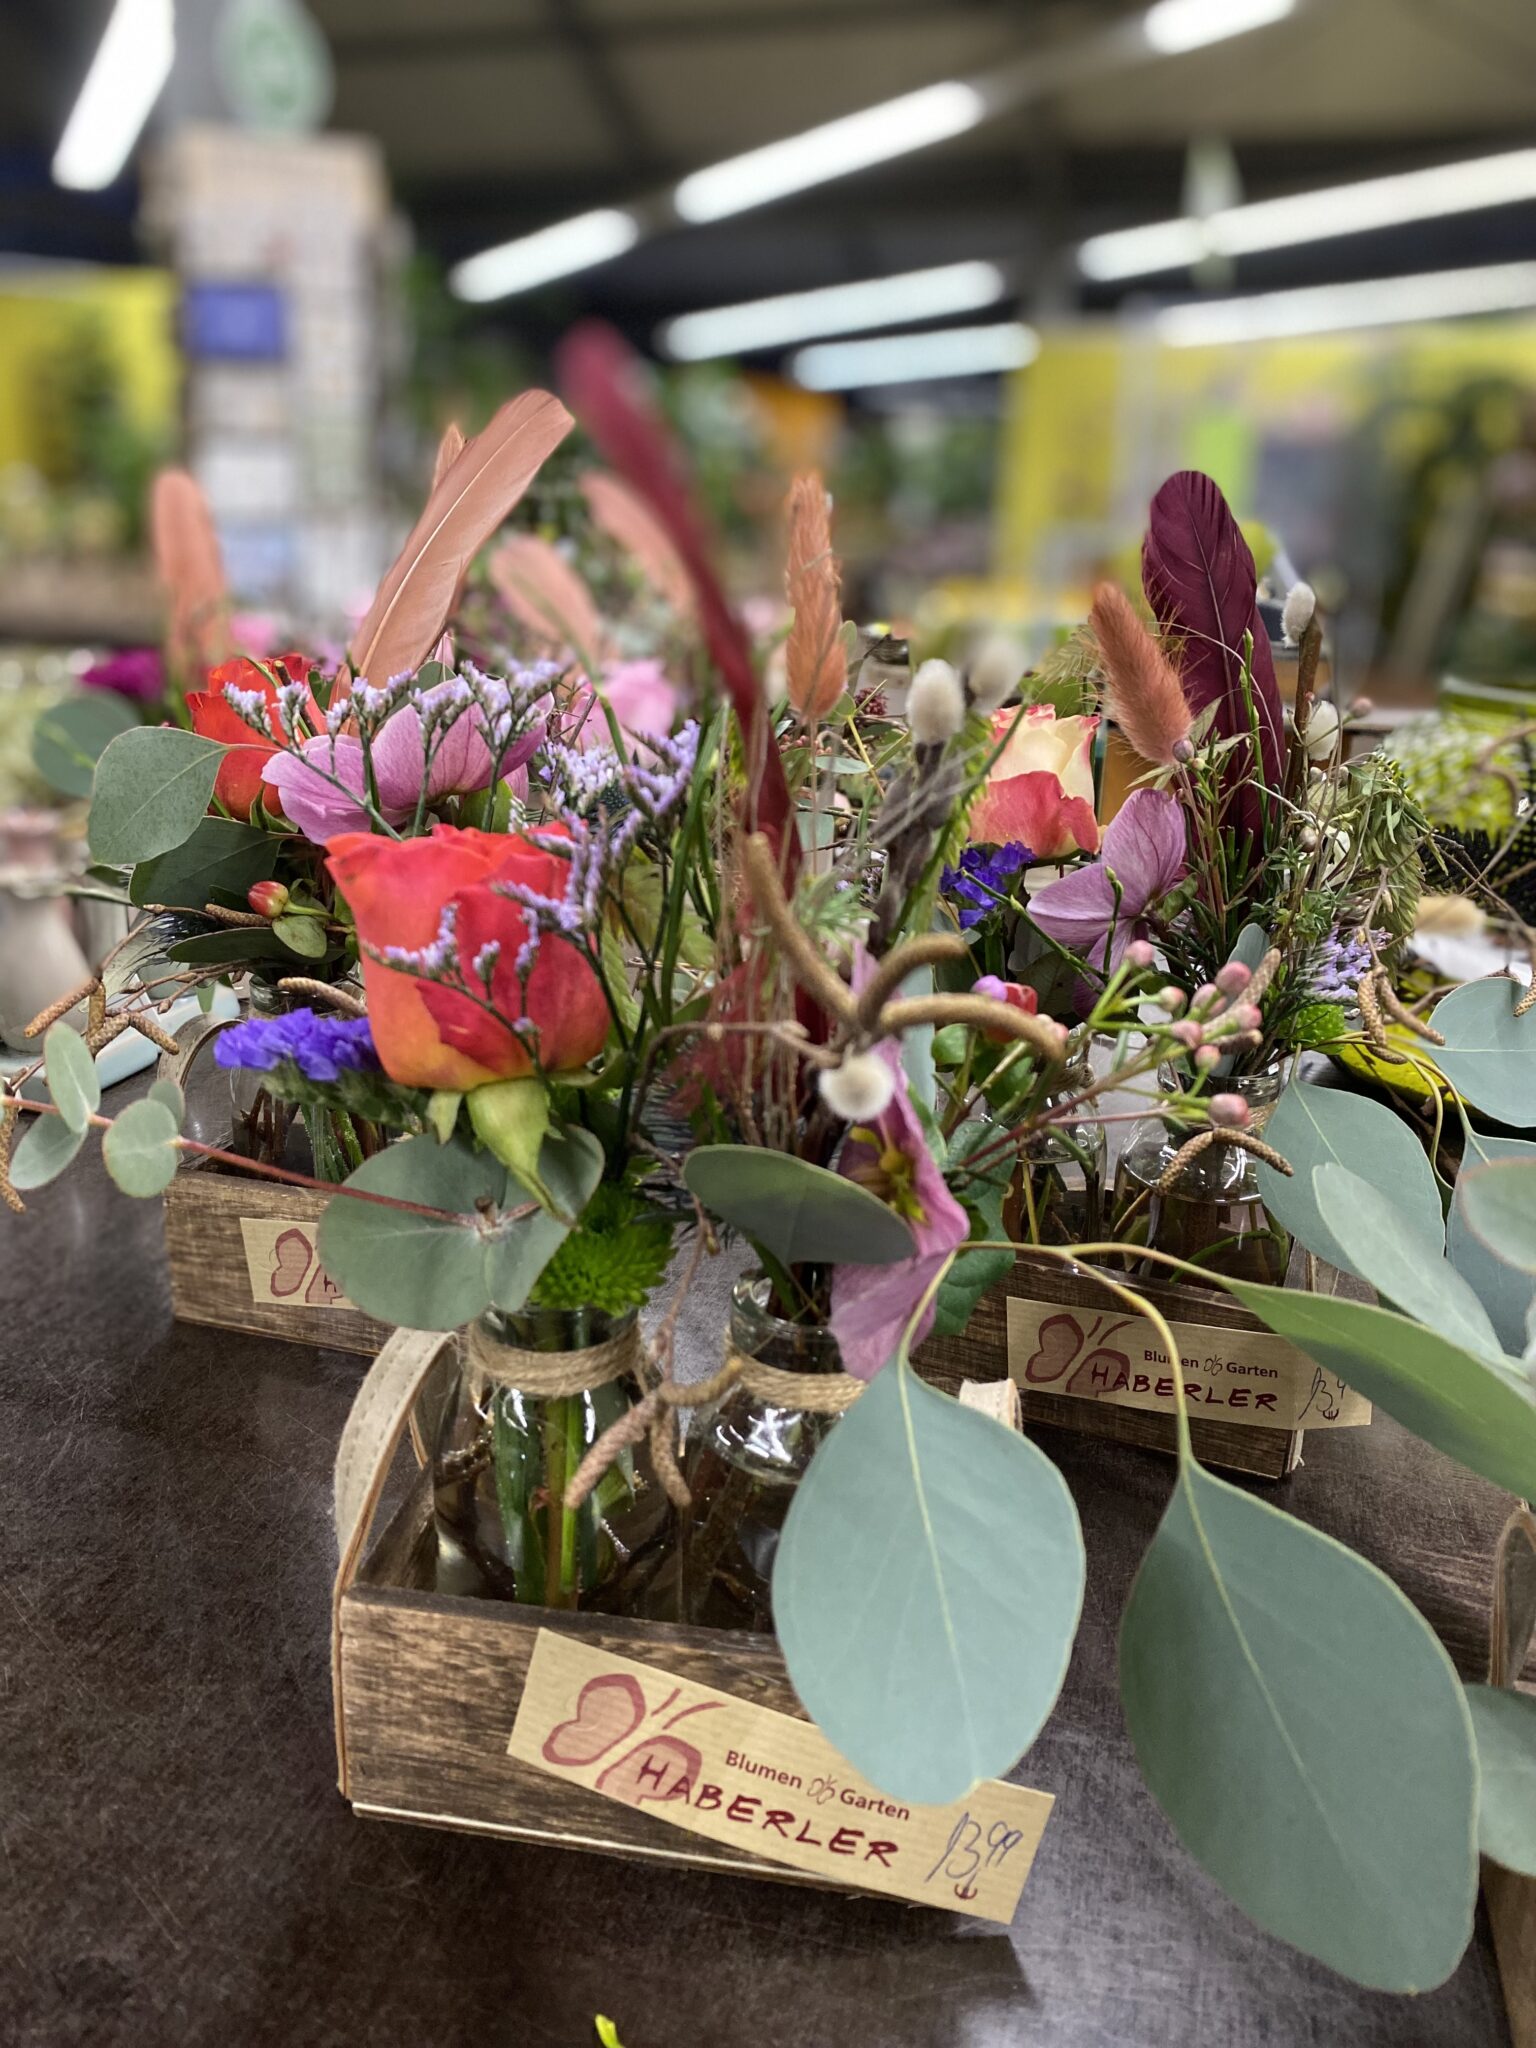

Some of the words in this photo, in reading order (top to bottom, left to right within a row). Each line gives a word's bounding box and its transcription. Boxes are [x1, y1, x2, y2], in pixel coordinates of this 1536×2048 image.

[1091, 1361, 1279, 1412] HABERLER
[1143, 1349, 1199, 1369] Bluen
[1226, 1361, 1279, 1379] Garten
[635, 1754, 900, 1868] HABERLER
[724, 1750, 803, 1789] Blumen
[839, 1788, 911, 1821] Garten
